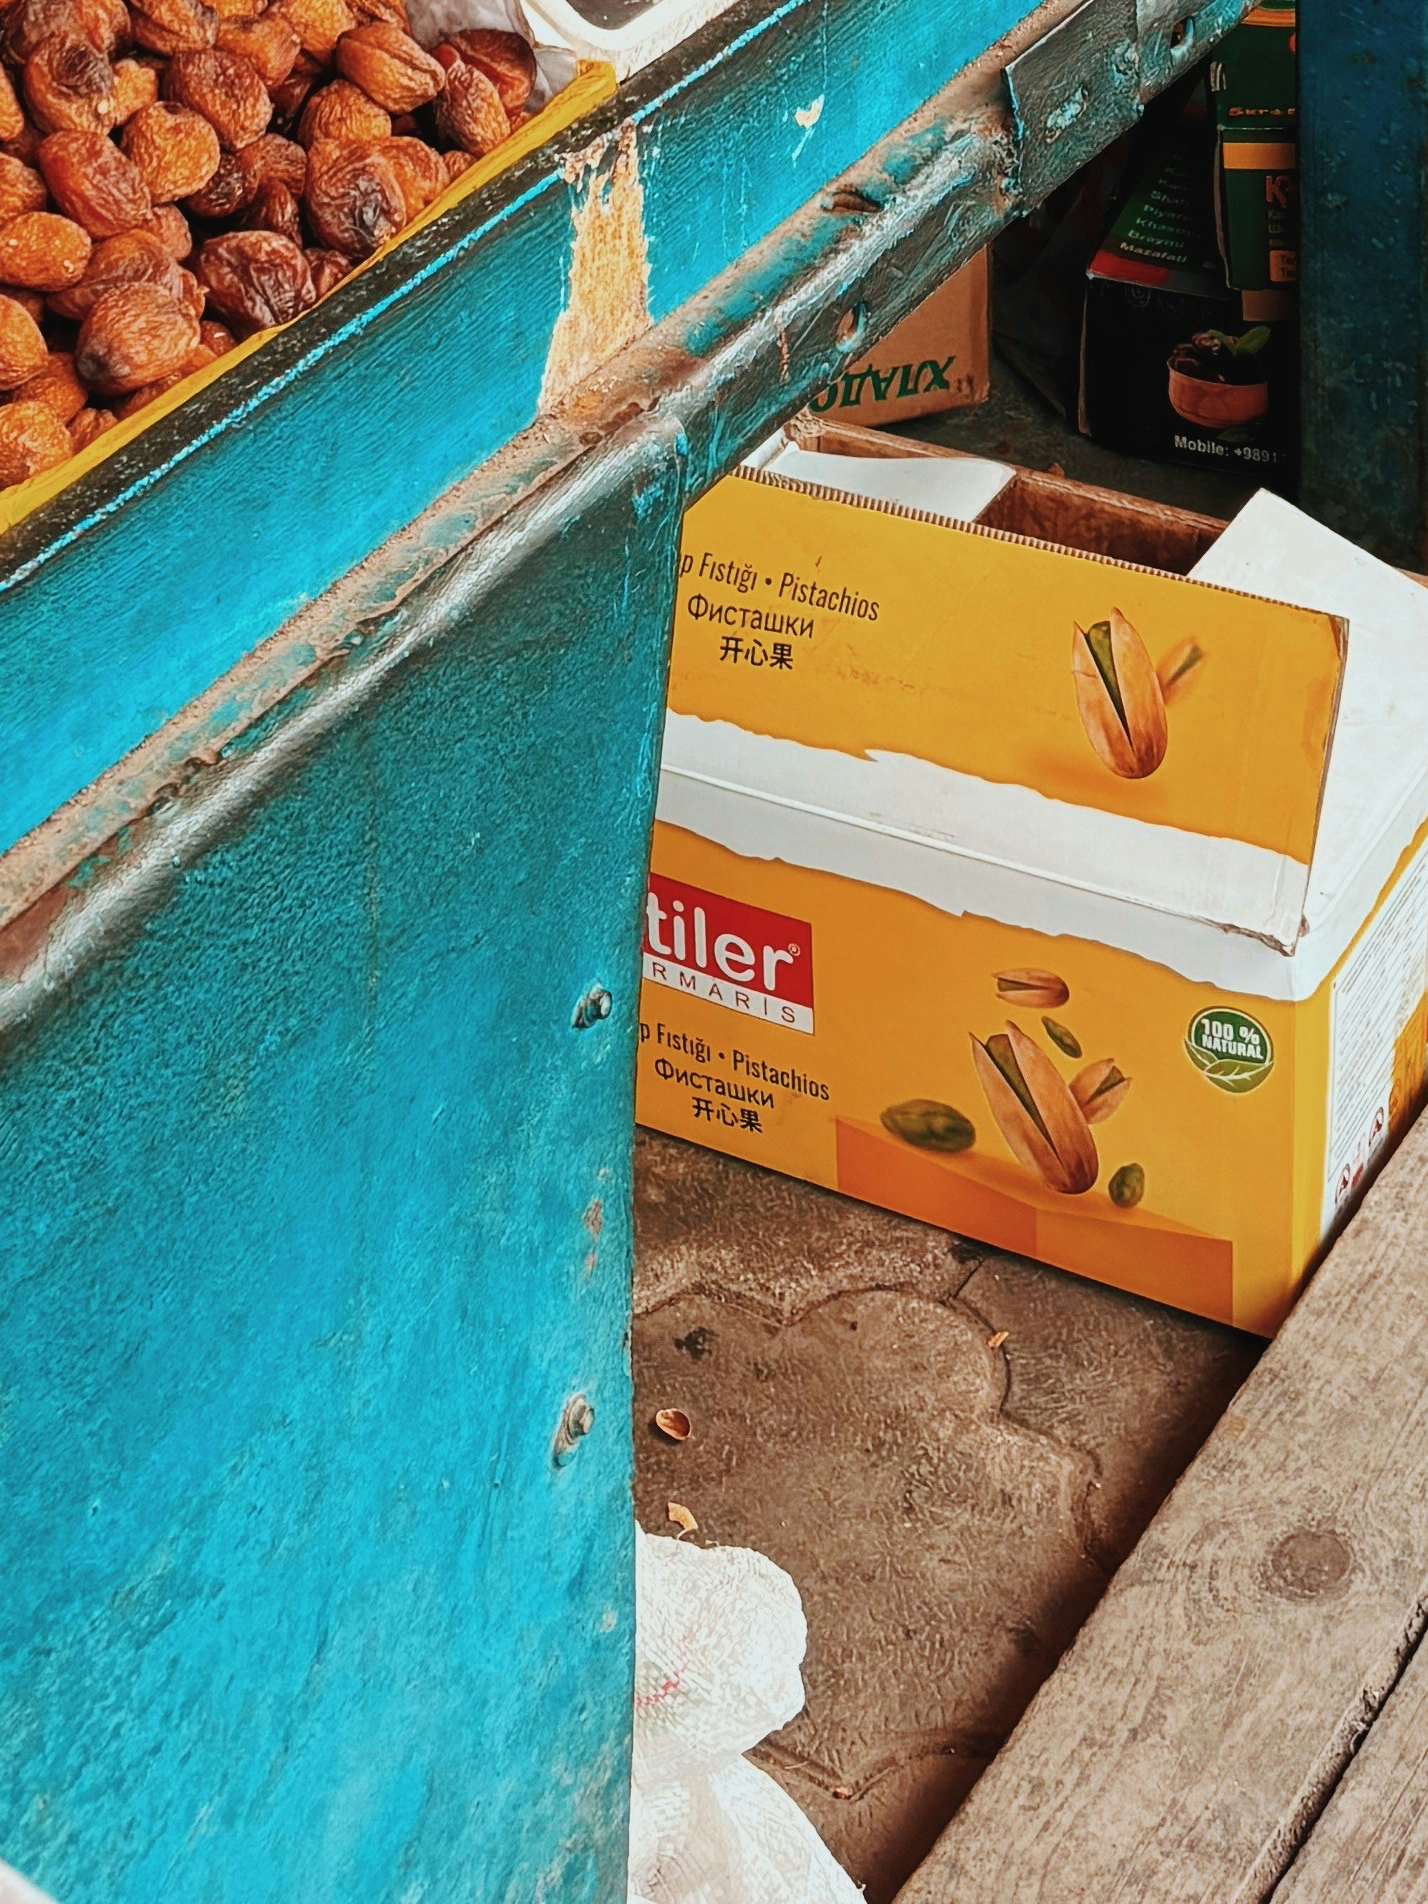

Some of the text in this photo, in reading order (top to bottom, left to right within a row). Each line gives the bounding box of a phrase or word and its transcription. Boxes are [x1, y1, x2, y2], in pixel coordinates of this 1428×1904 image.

[808, 354, 957, 414] ХЛАДО
[1173, 434, 1287, 464] Mobile: +9891
[687, 593, 815, 639] Фисташки
[778, 571, 881, 622] Pistachios
[719, 635, 794, 671] 开心果
[646, 891, 794, 992] tiler
[651, 960, 797, 1026] RMARIS
[1201, 1018, 1234, 1041] 100
[1201, 1034, 1265, 1060] NATURAL
[654, 1057, 775, 1110] Фисташки
[732, 1048, 830, 1102] Pistachios
[691, 1096, 764, 1134] 开心果
